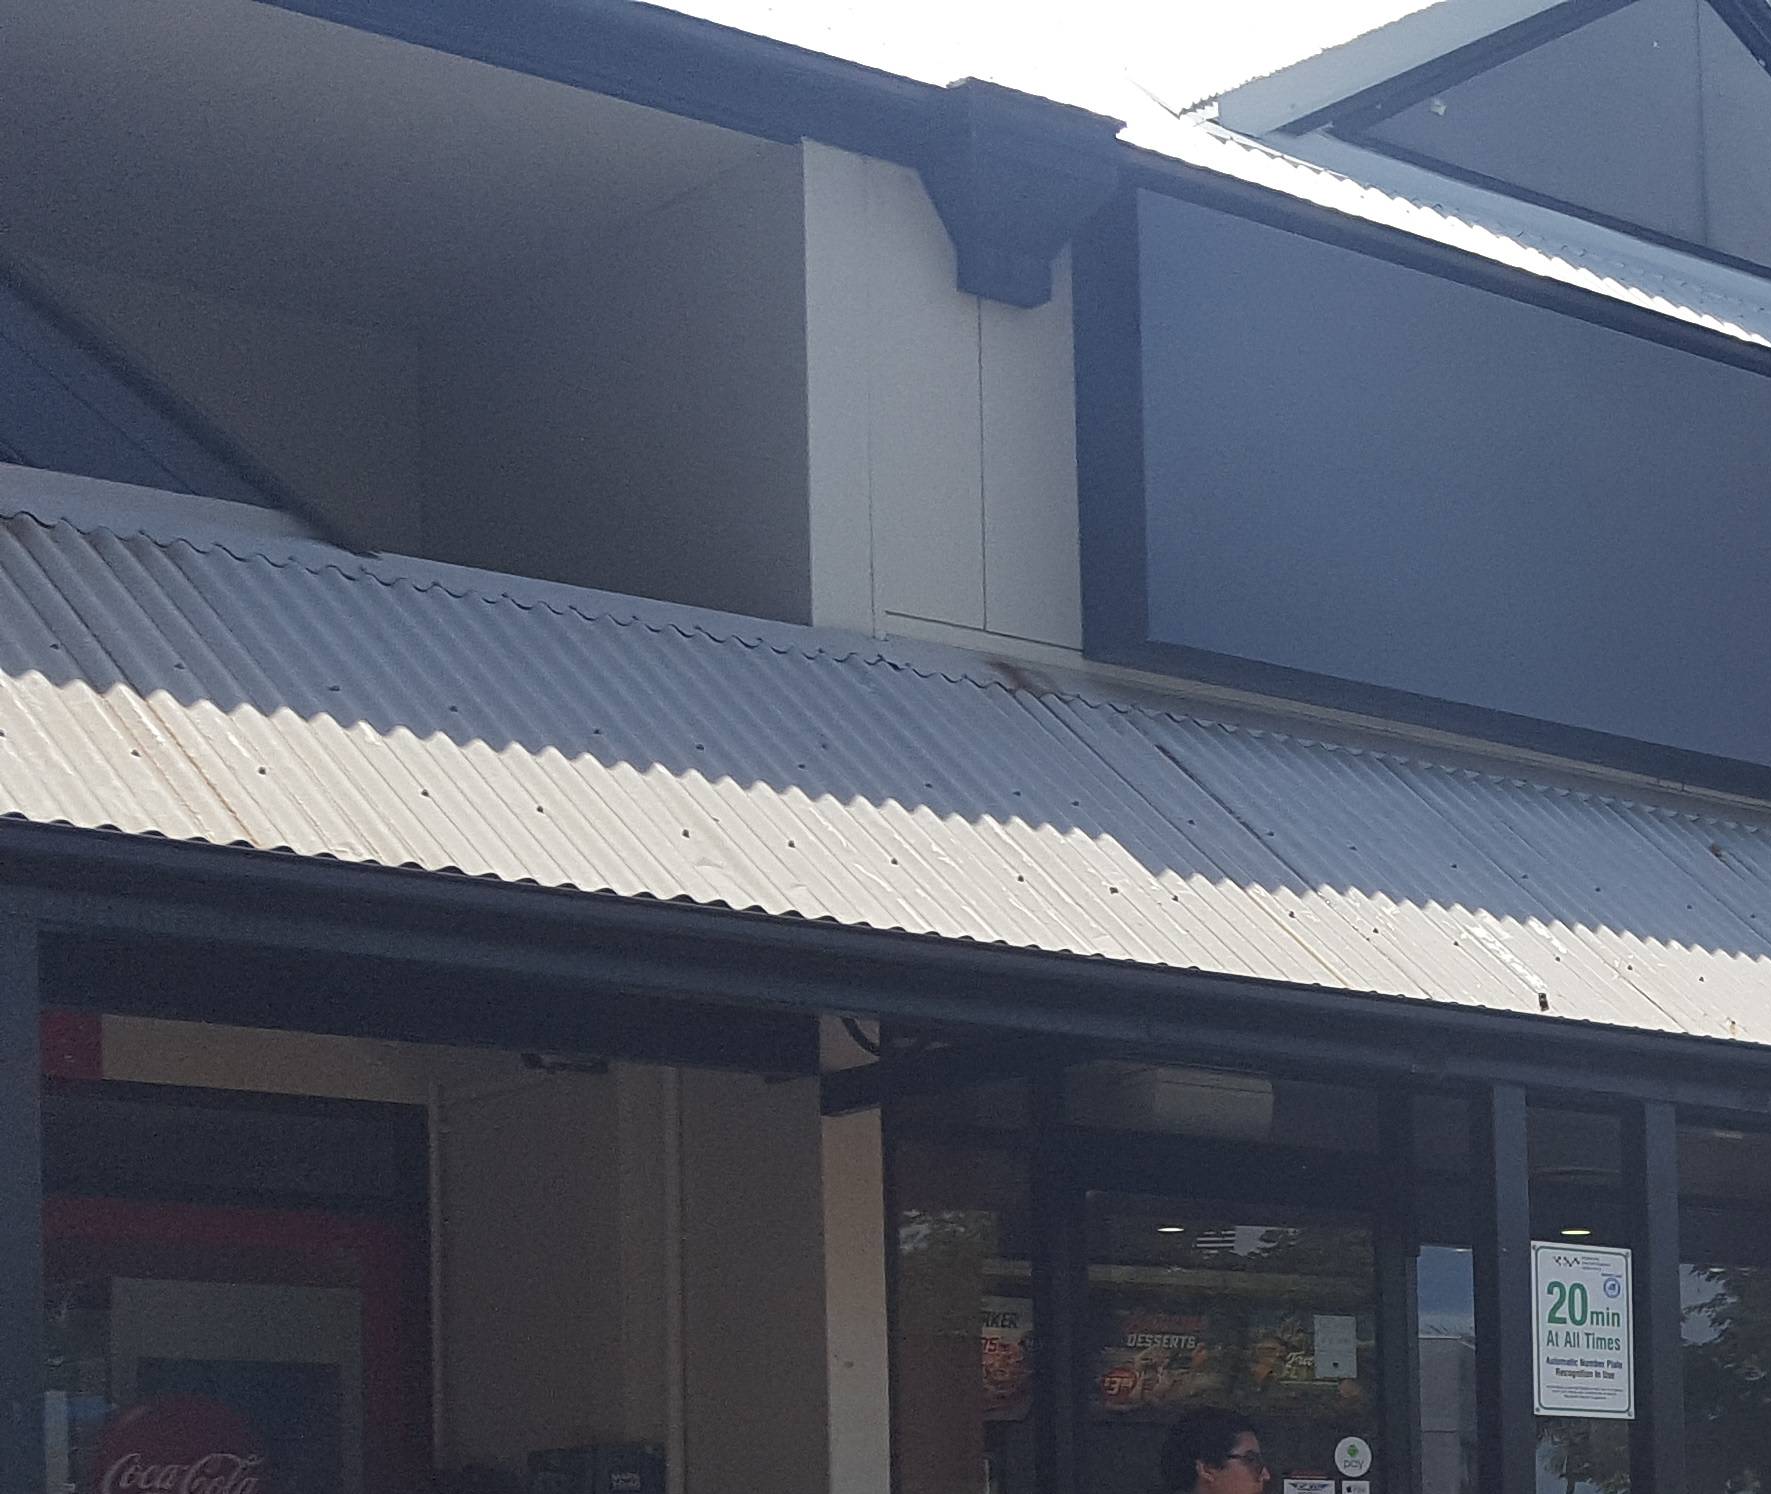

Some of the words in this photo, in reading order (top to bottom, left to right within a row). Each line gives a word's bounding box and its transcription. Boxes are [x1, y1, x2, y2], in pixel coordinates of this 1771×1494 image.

[1546, 1280, 1588, 1326] 20
[1590, 1307, 1621, 1328] min
[1126, 1333, 1196, 1350] DESSERTS
[1546, 1330, 1559, 1347] At
[1564, 1330, 1580, 1349] All
[1584, 1332, 1621, 1351] Times
